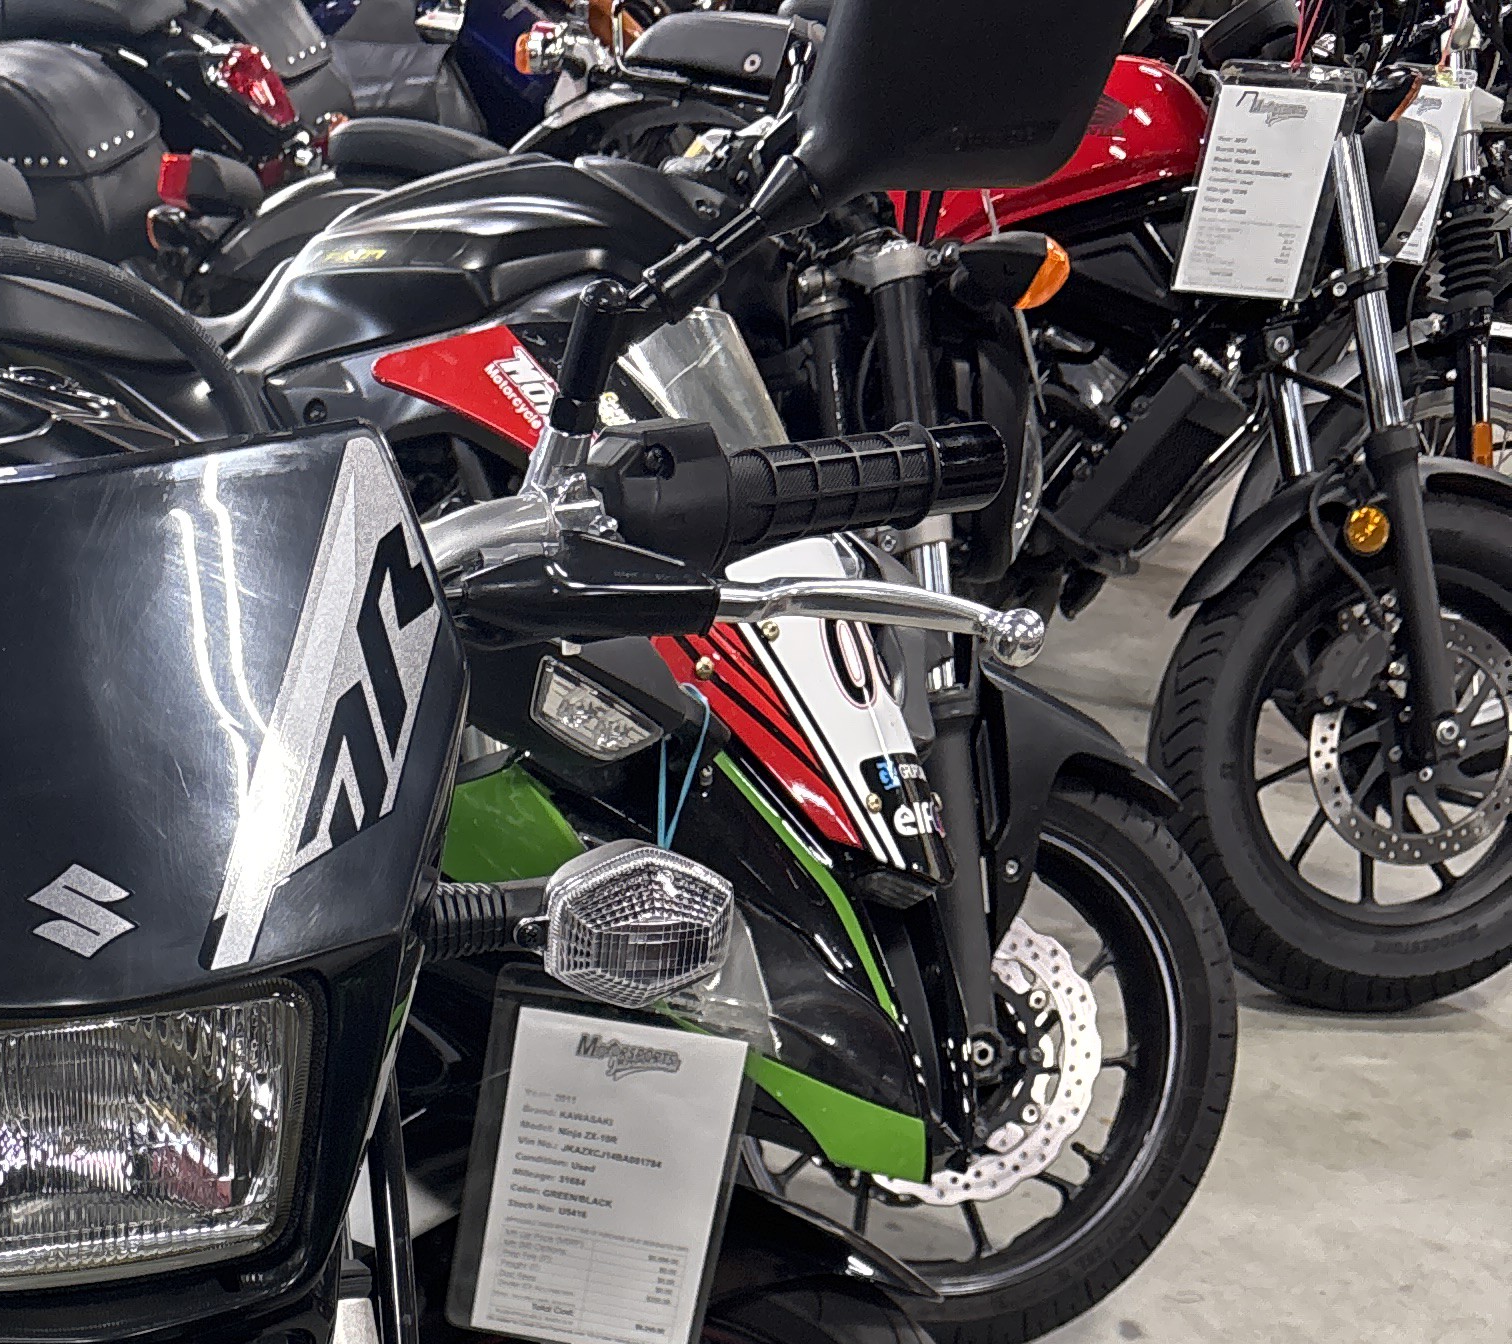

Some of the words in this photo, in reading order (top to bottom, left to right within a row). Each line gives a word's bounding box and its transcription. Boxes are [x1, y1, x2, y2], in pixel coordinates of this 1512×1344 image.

[484, 361, 544, 430] Motorcycle
[559, 1110, 614, 1127] KAWASAKI
[558, 1126, 582, 1140] Ninja
[571, 1161, 596, 1173] Used
